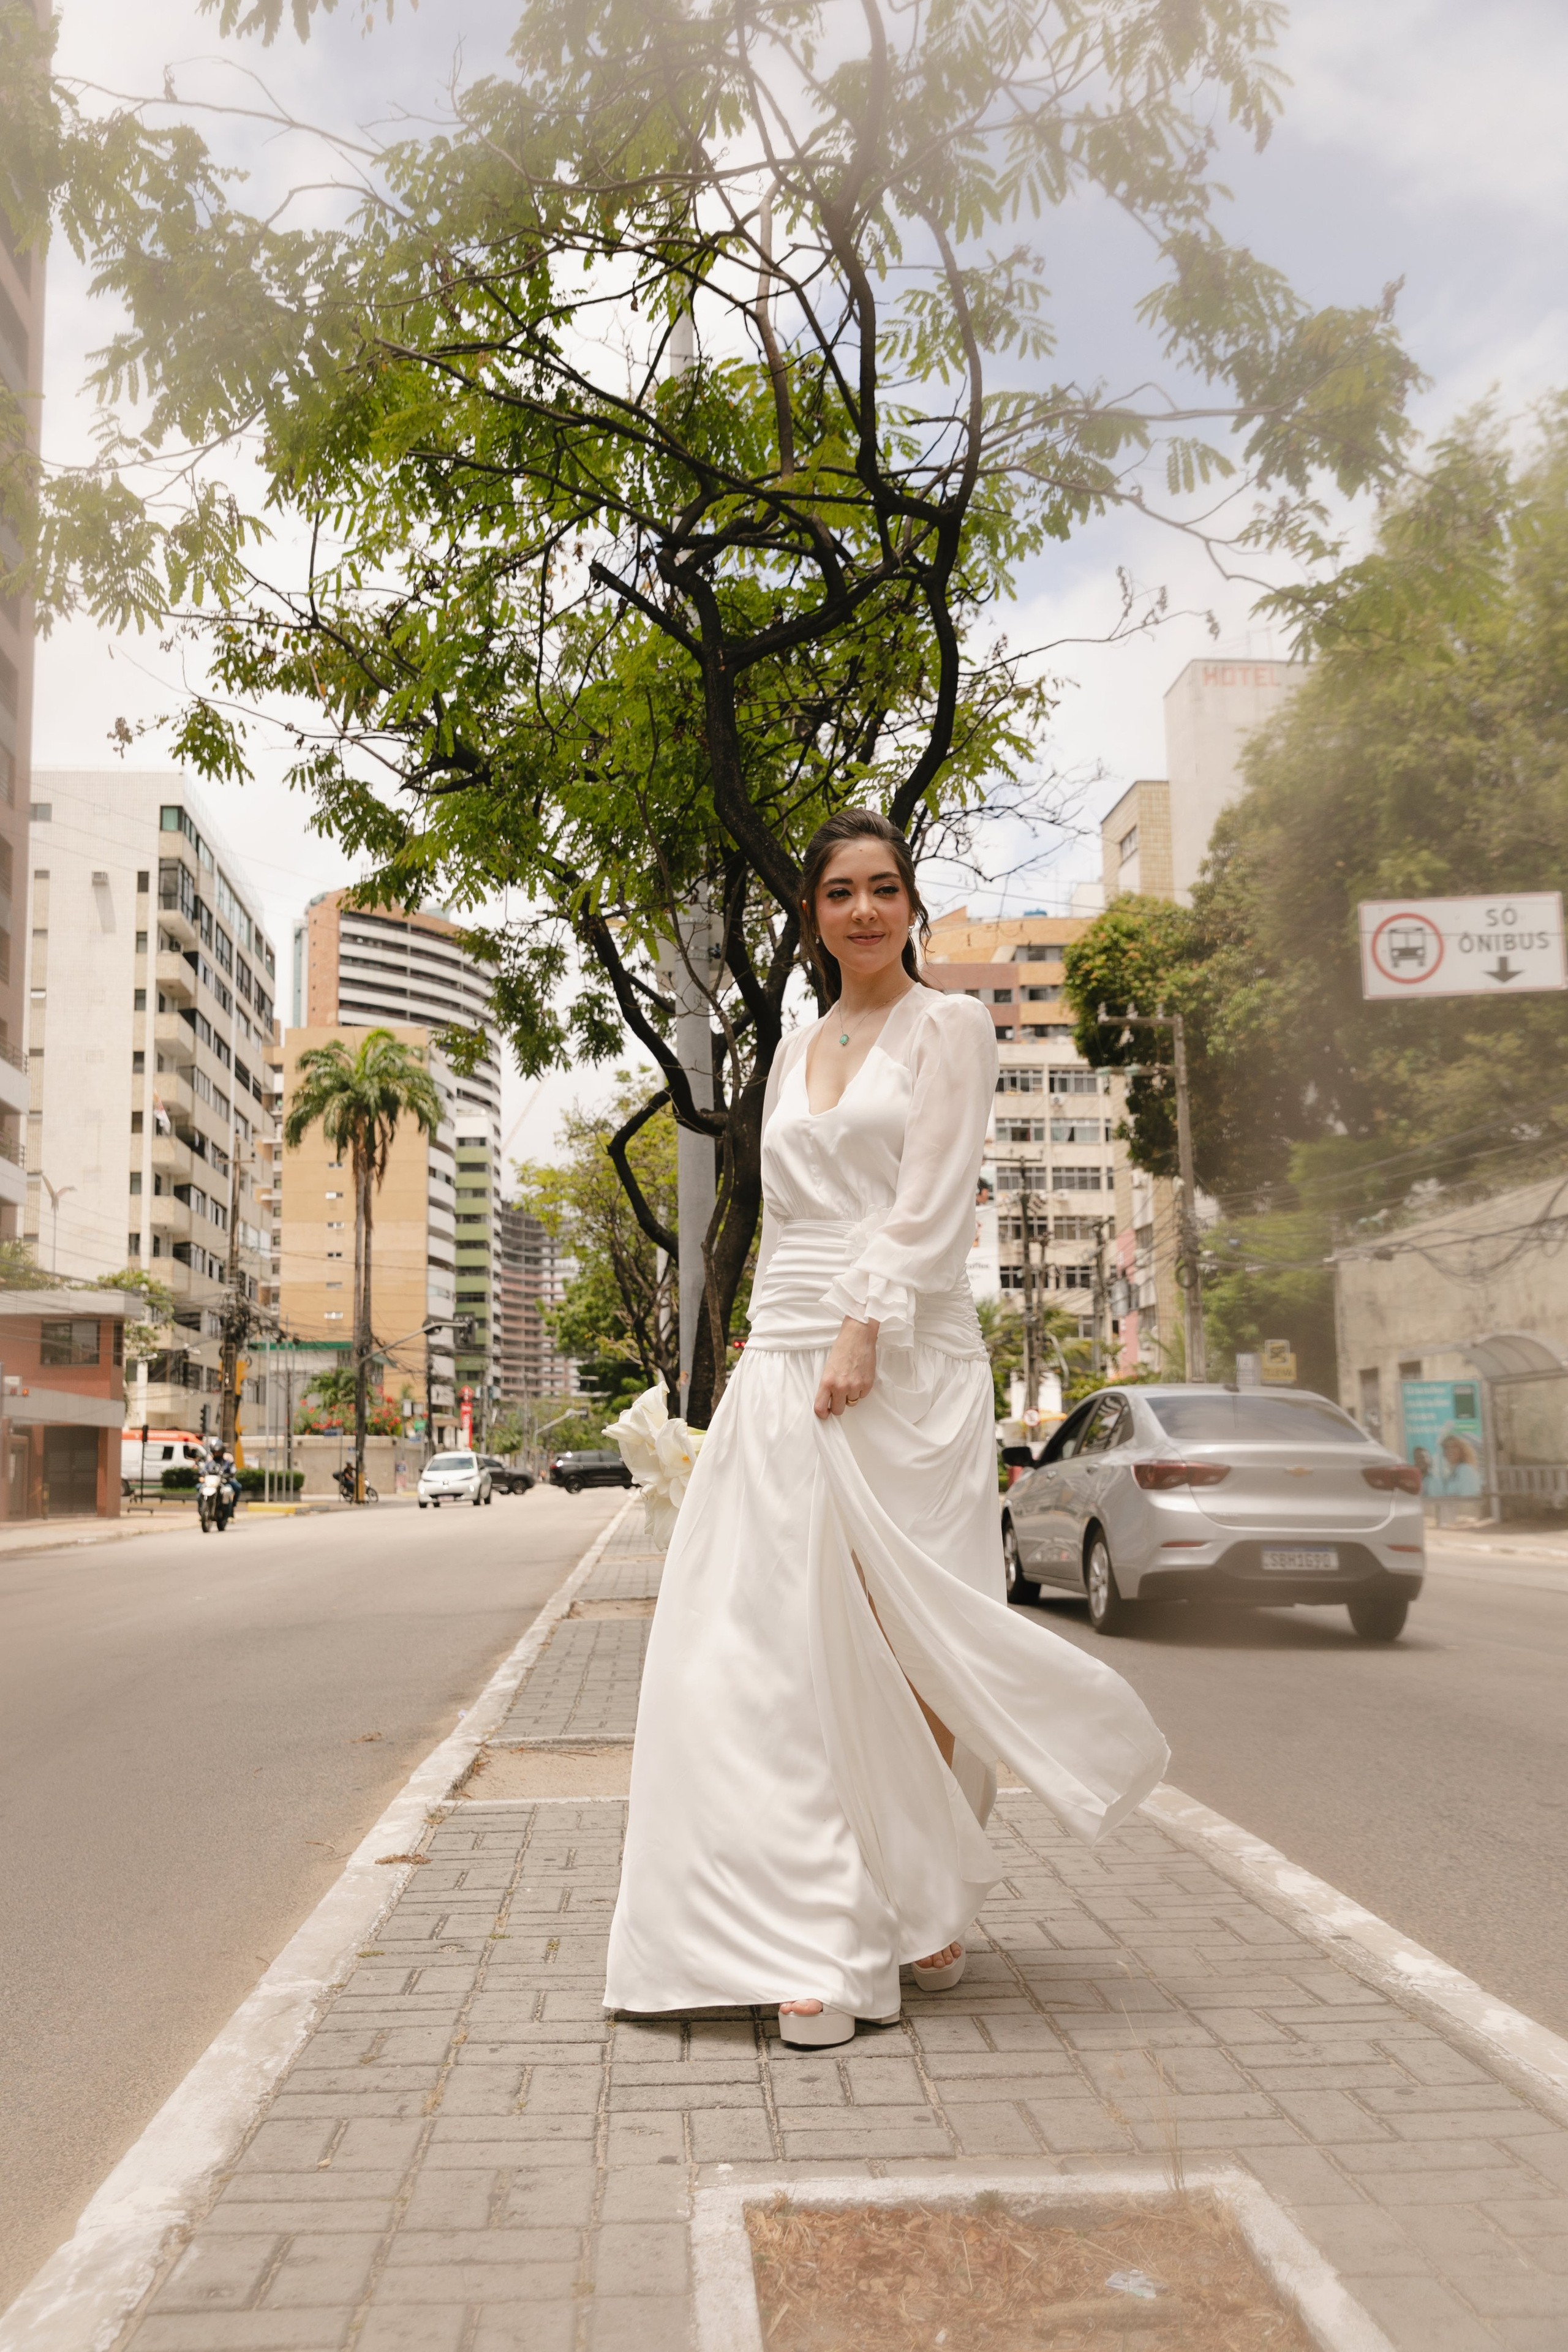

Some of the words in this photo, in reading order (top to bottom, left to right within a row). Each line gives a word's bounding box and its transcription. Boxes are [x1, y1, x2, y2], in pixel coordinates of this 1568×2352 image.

[1204, 666, 1281, 687] HOTEL
[1486, 903, 1517, 926] SÓ
[1459, 930, 1550, 953] ÔNIBUS
